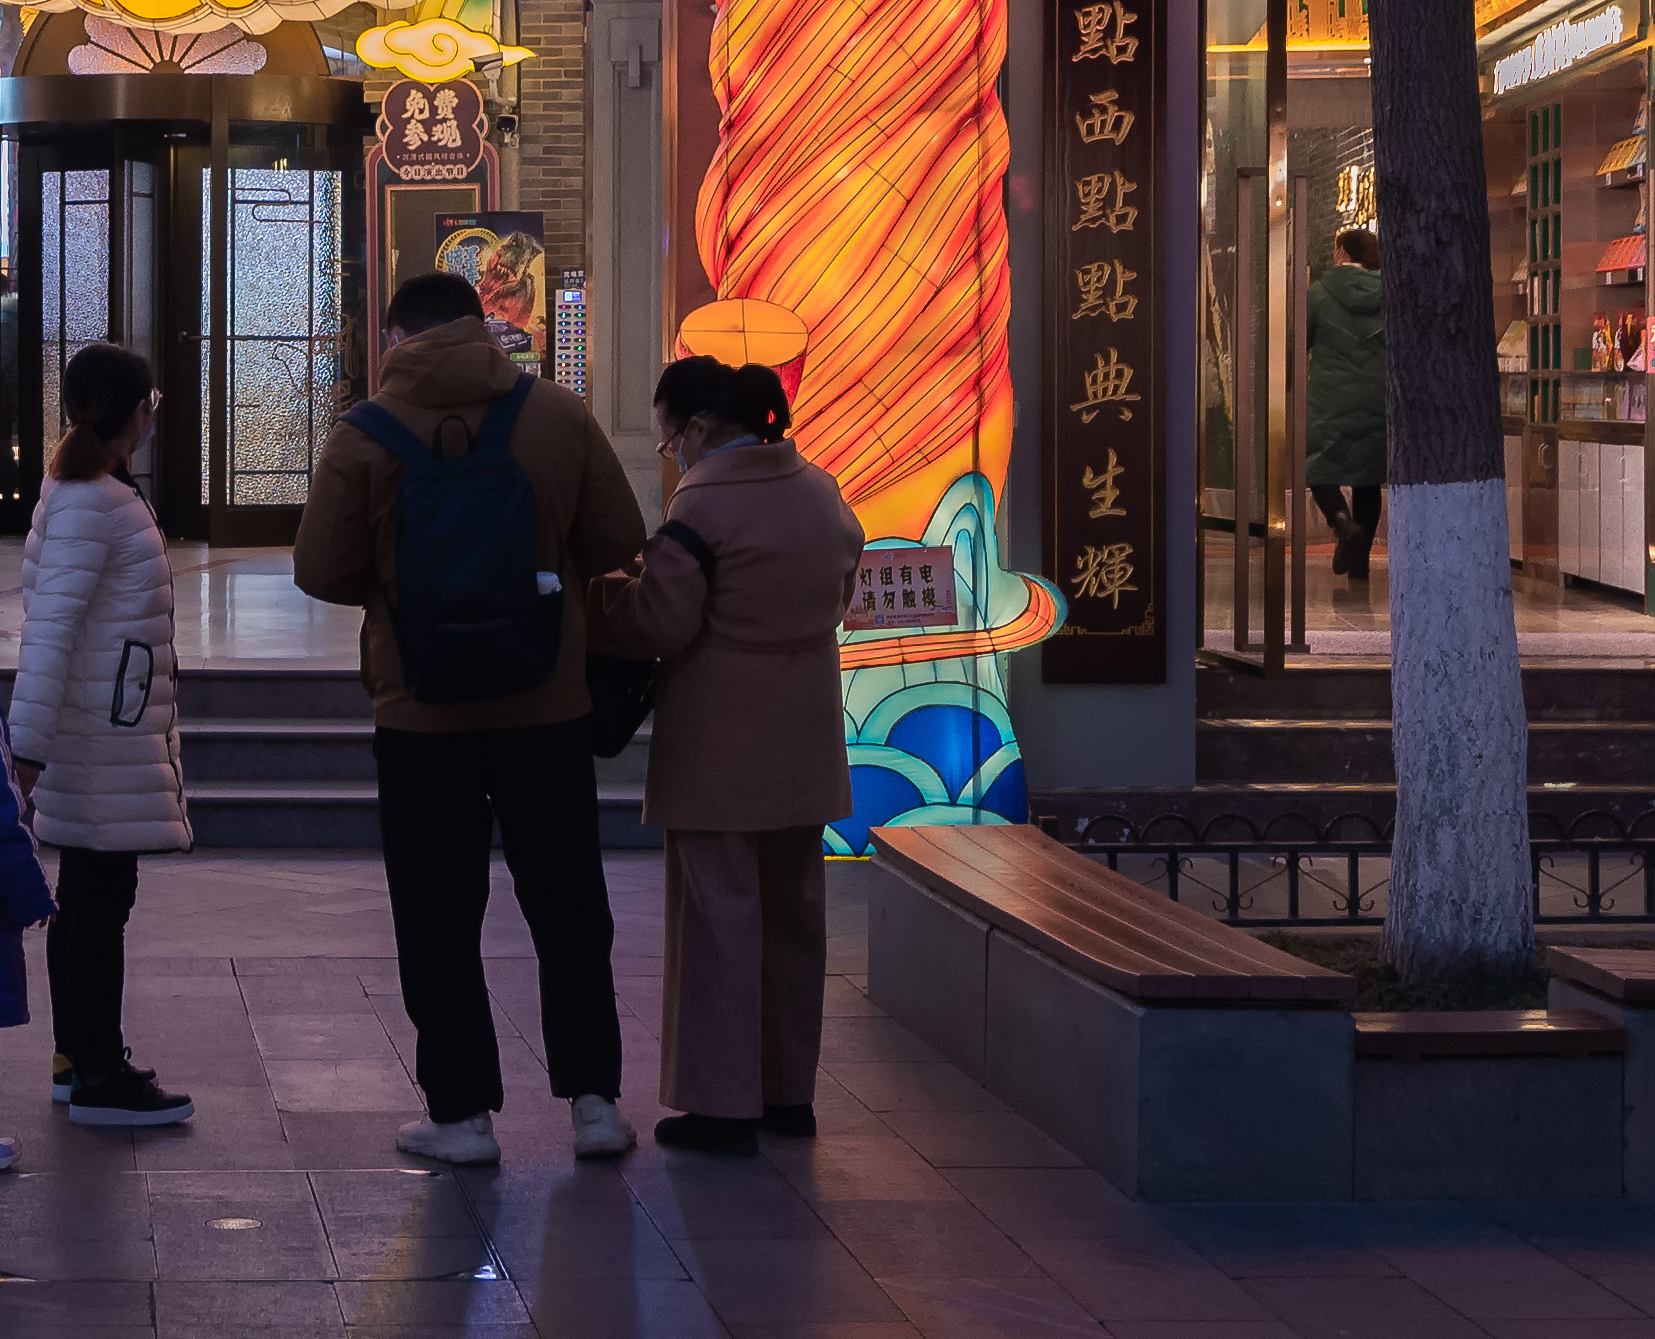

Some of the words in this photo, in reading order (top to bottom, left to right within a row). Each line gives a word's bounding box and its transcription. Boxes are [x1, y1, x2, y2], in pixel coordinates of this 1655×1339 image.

[401, 88, 459, 120] 免费
[402, 119, 463, 151] 参观
[402, 166, 465, 179] 今日演出节目
[858, 564, 934, 587] 灯组有电
[861, 587, 937, 611] 请勿触摸
